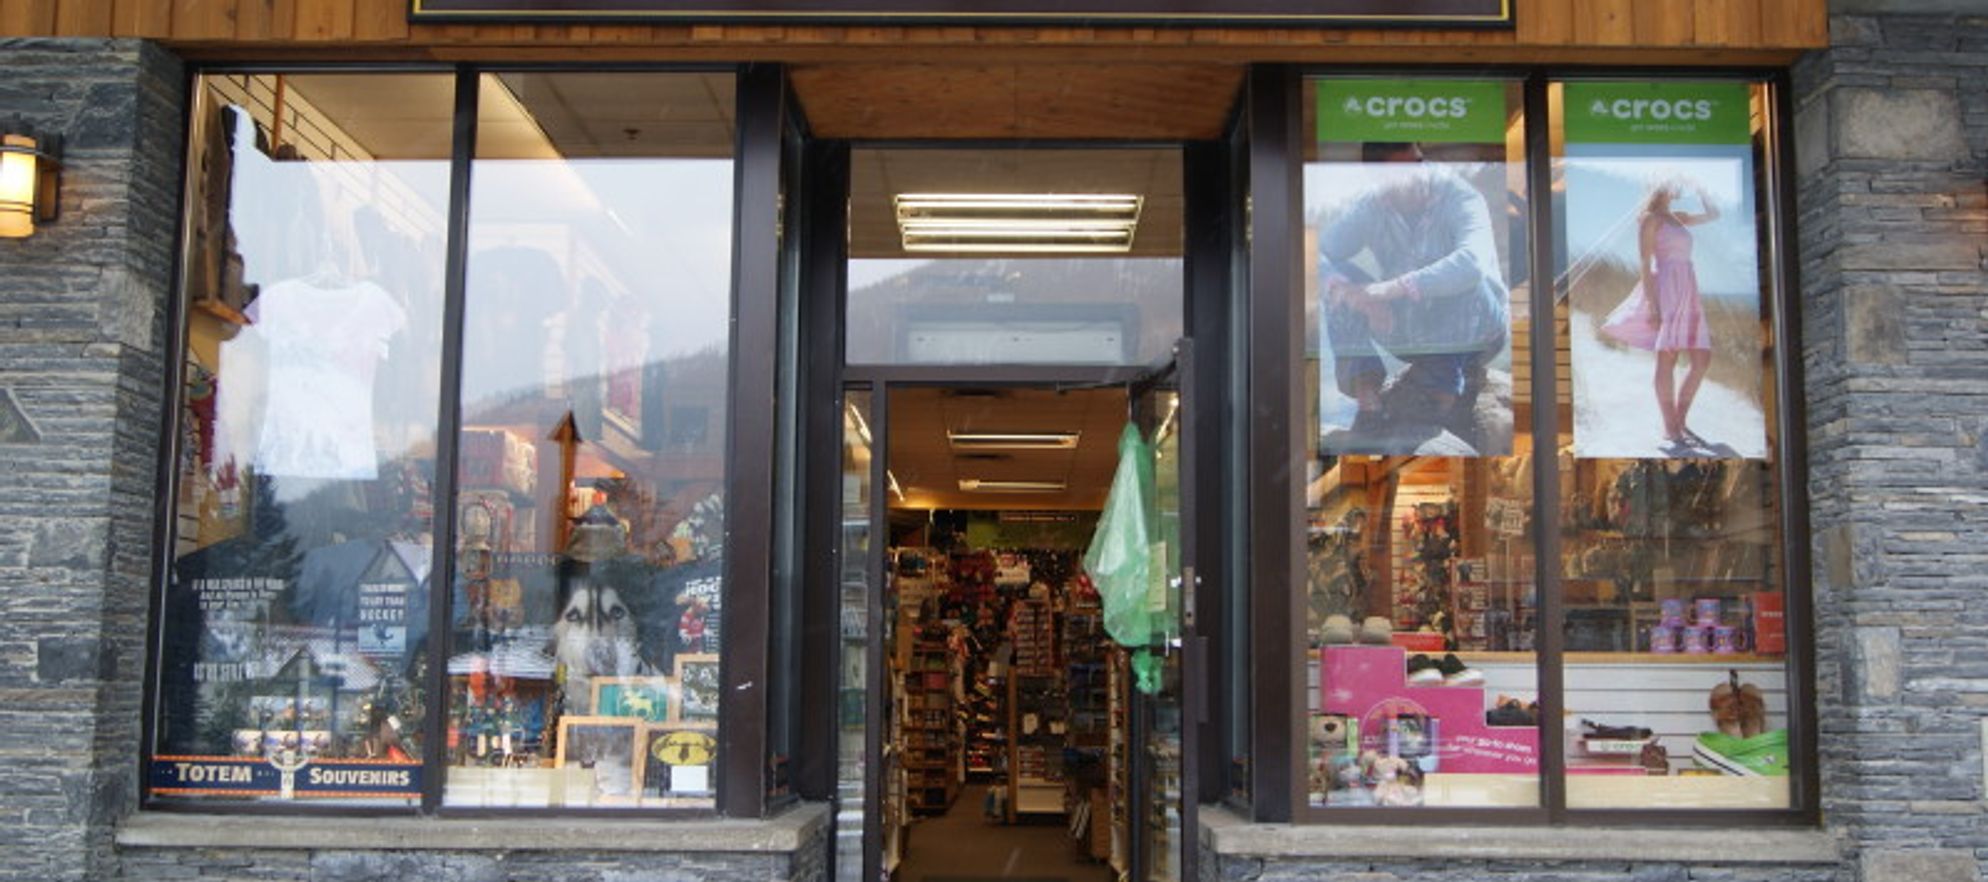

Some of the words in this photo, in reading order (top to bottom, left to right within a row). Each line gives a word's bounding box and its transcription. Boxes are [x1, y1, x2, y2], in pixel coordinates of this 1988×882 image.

[1366, 95, 1468, 118] crocs
[1612, 98, 1712, 120] crocs
[175, 762, 253, 783] TOTEM
[309, 767, 411, 787] SOUVENIRS
